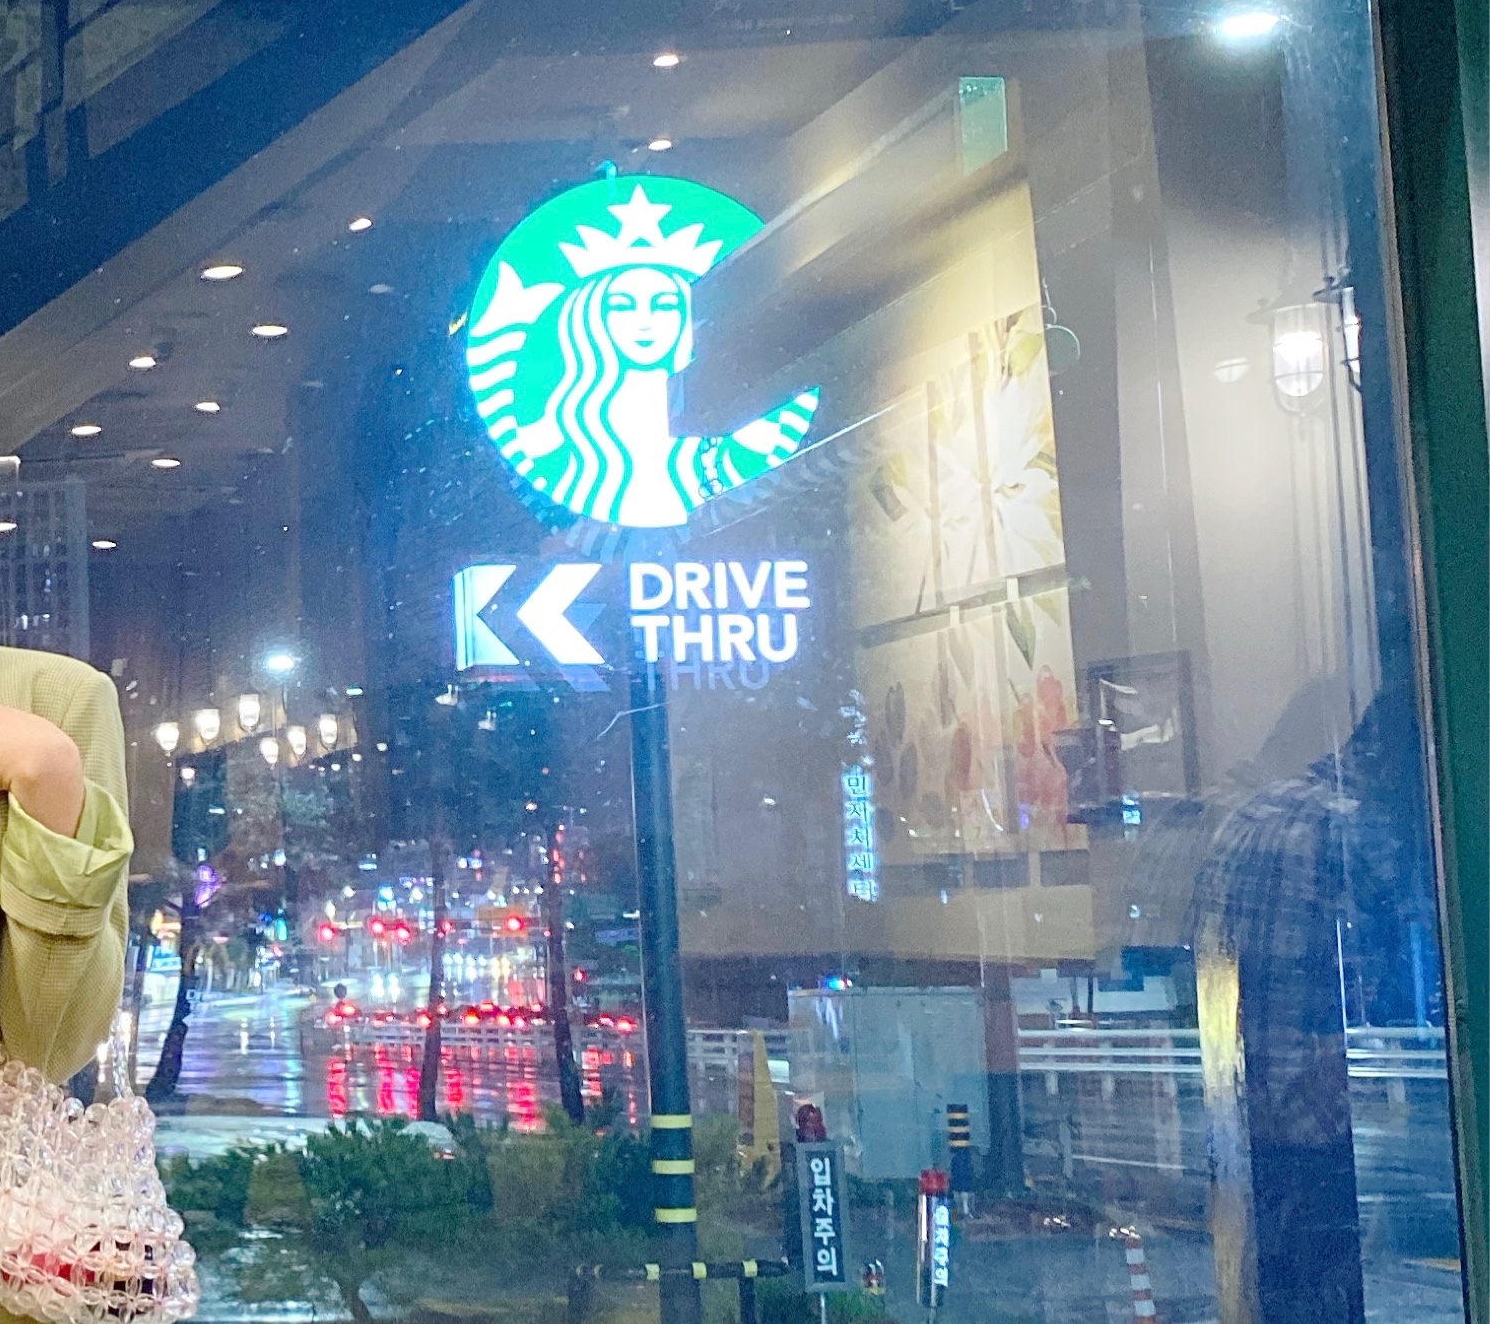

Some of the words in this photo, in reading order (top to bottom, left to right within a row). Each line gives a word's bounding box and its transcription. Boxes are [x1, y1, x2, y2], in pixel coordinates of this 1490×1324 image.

[629, 560, 811, 610] DRIVE
[630, 613, 799, 663] THRU
[810, 1157, 838, 1276] 입차주의
